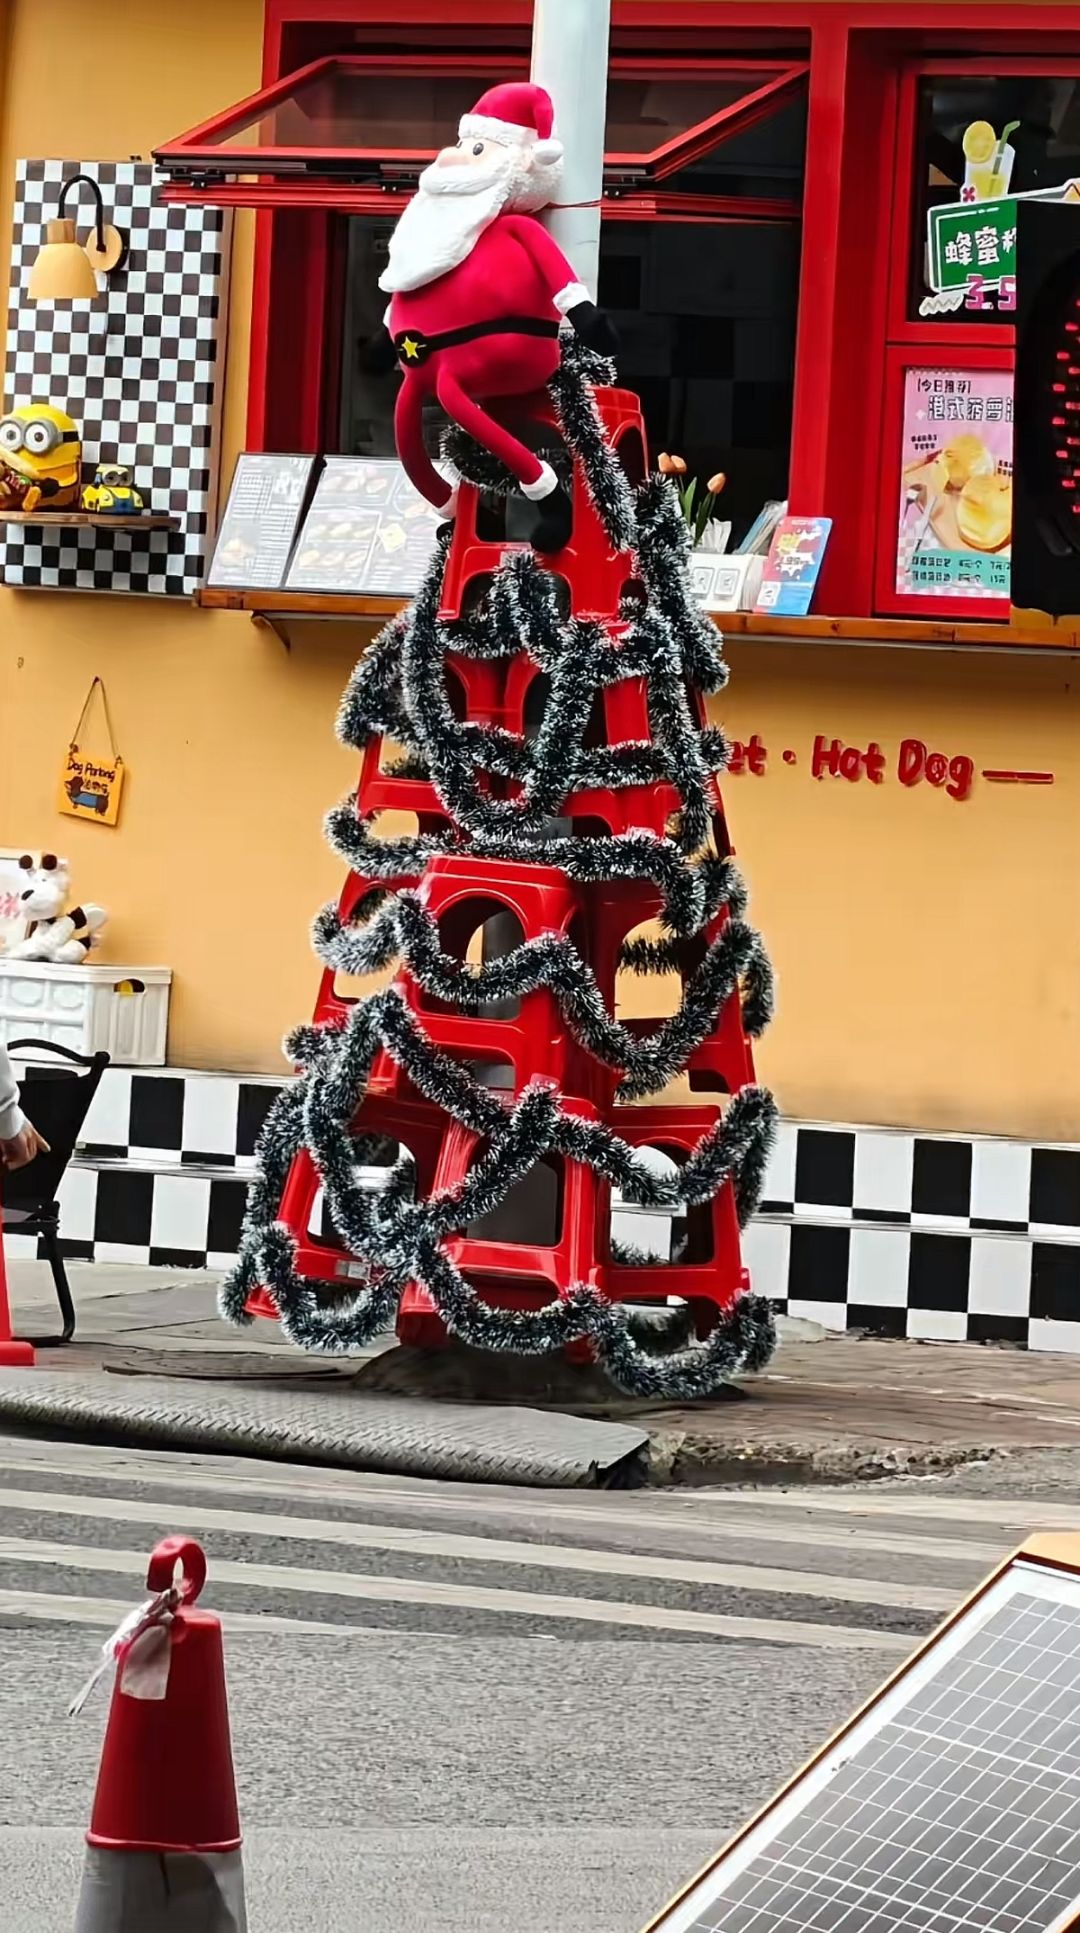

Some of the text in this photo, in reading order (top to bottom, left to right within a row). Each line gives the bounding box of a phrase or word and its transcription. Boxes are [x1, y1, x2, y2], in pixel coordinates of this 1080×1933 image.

[67, 759, 83, 774] Dog
[811, 735, 886, 784] Hot
[897, 738, 974, 801] Dog
